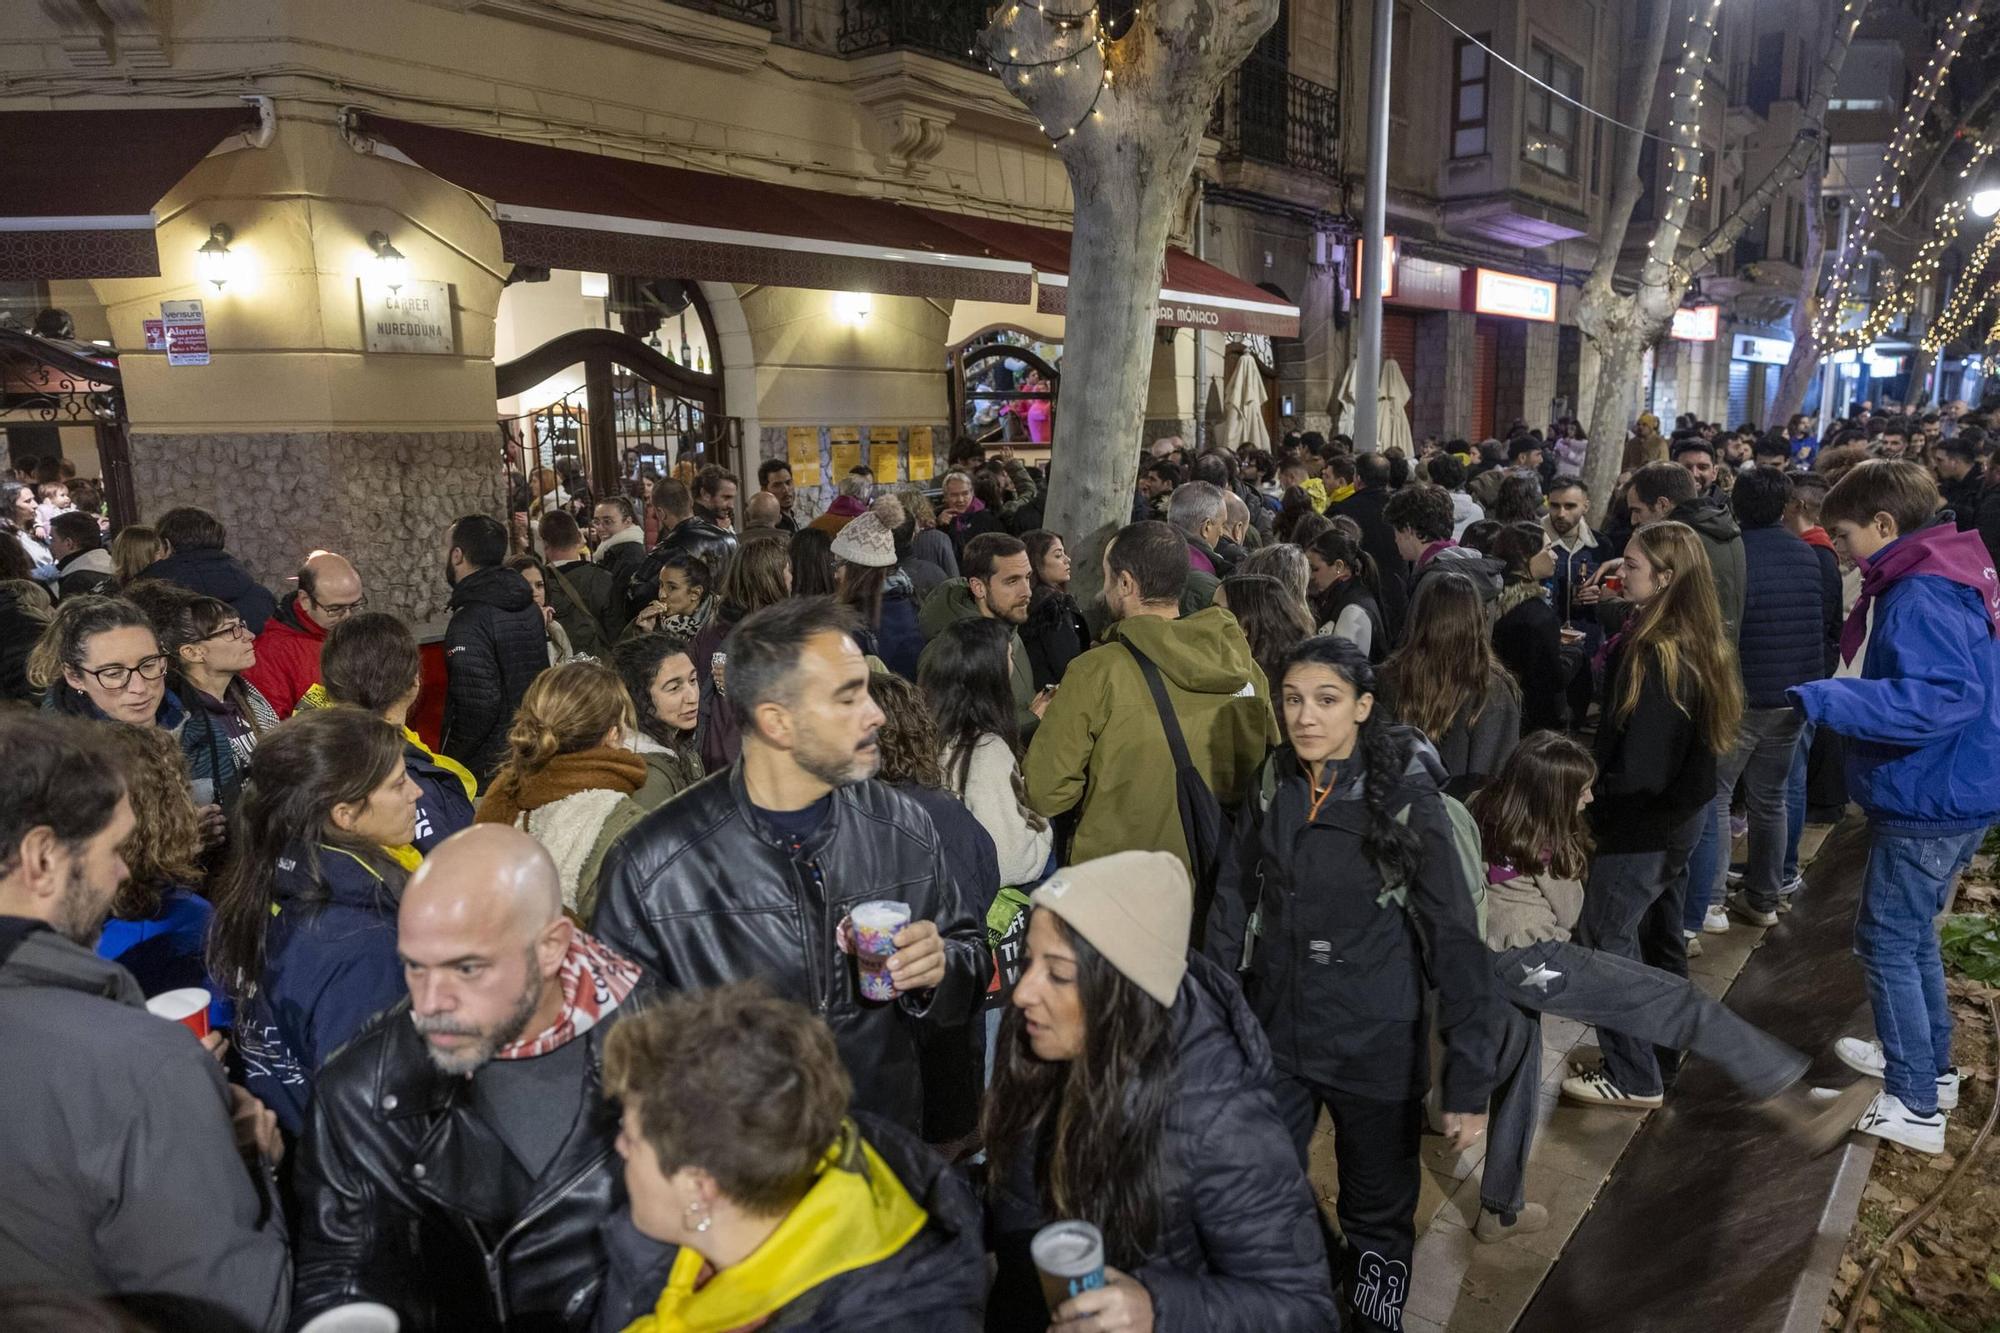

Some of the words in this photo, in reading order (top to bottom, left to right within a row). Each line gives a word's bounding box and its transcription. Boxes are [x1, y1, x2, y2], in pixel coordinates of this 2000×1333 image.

[386, 297, 430, 312] CARRER
[1176, 306, 1219, 325] MÓNACO
[168, 327, 205, 335] Alarma
[376, 322, 442, 337] NUREDDUNA
